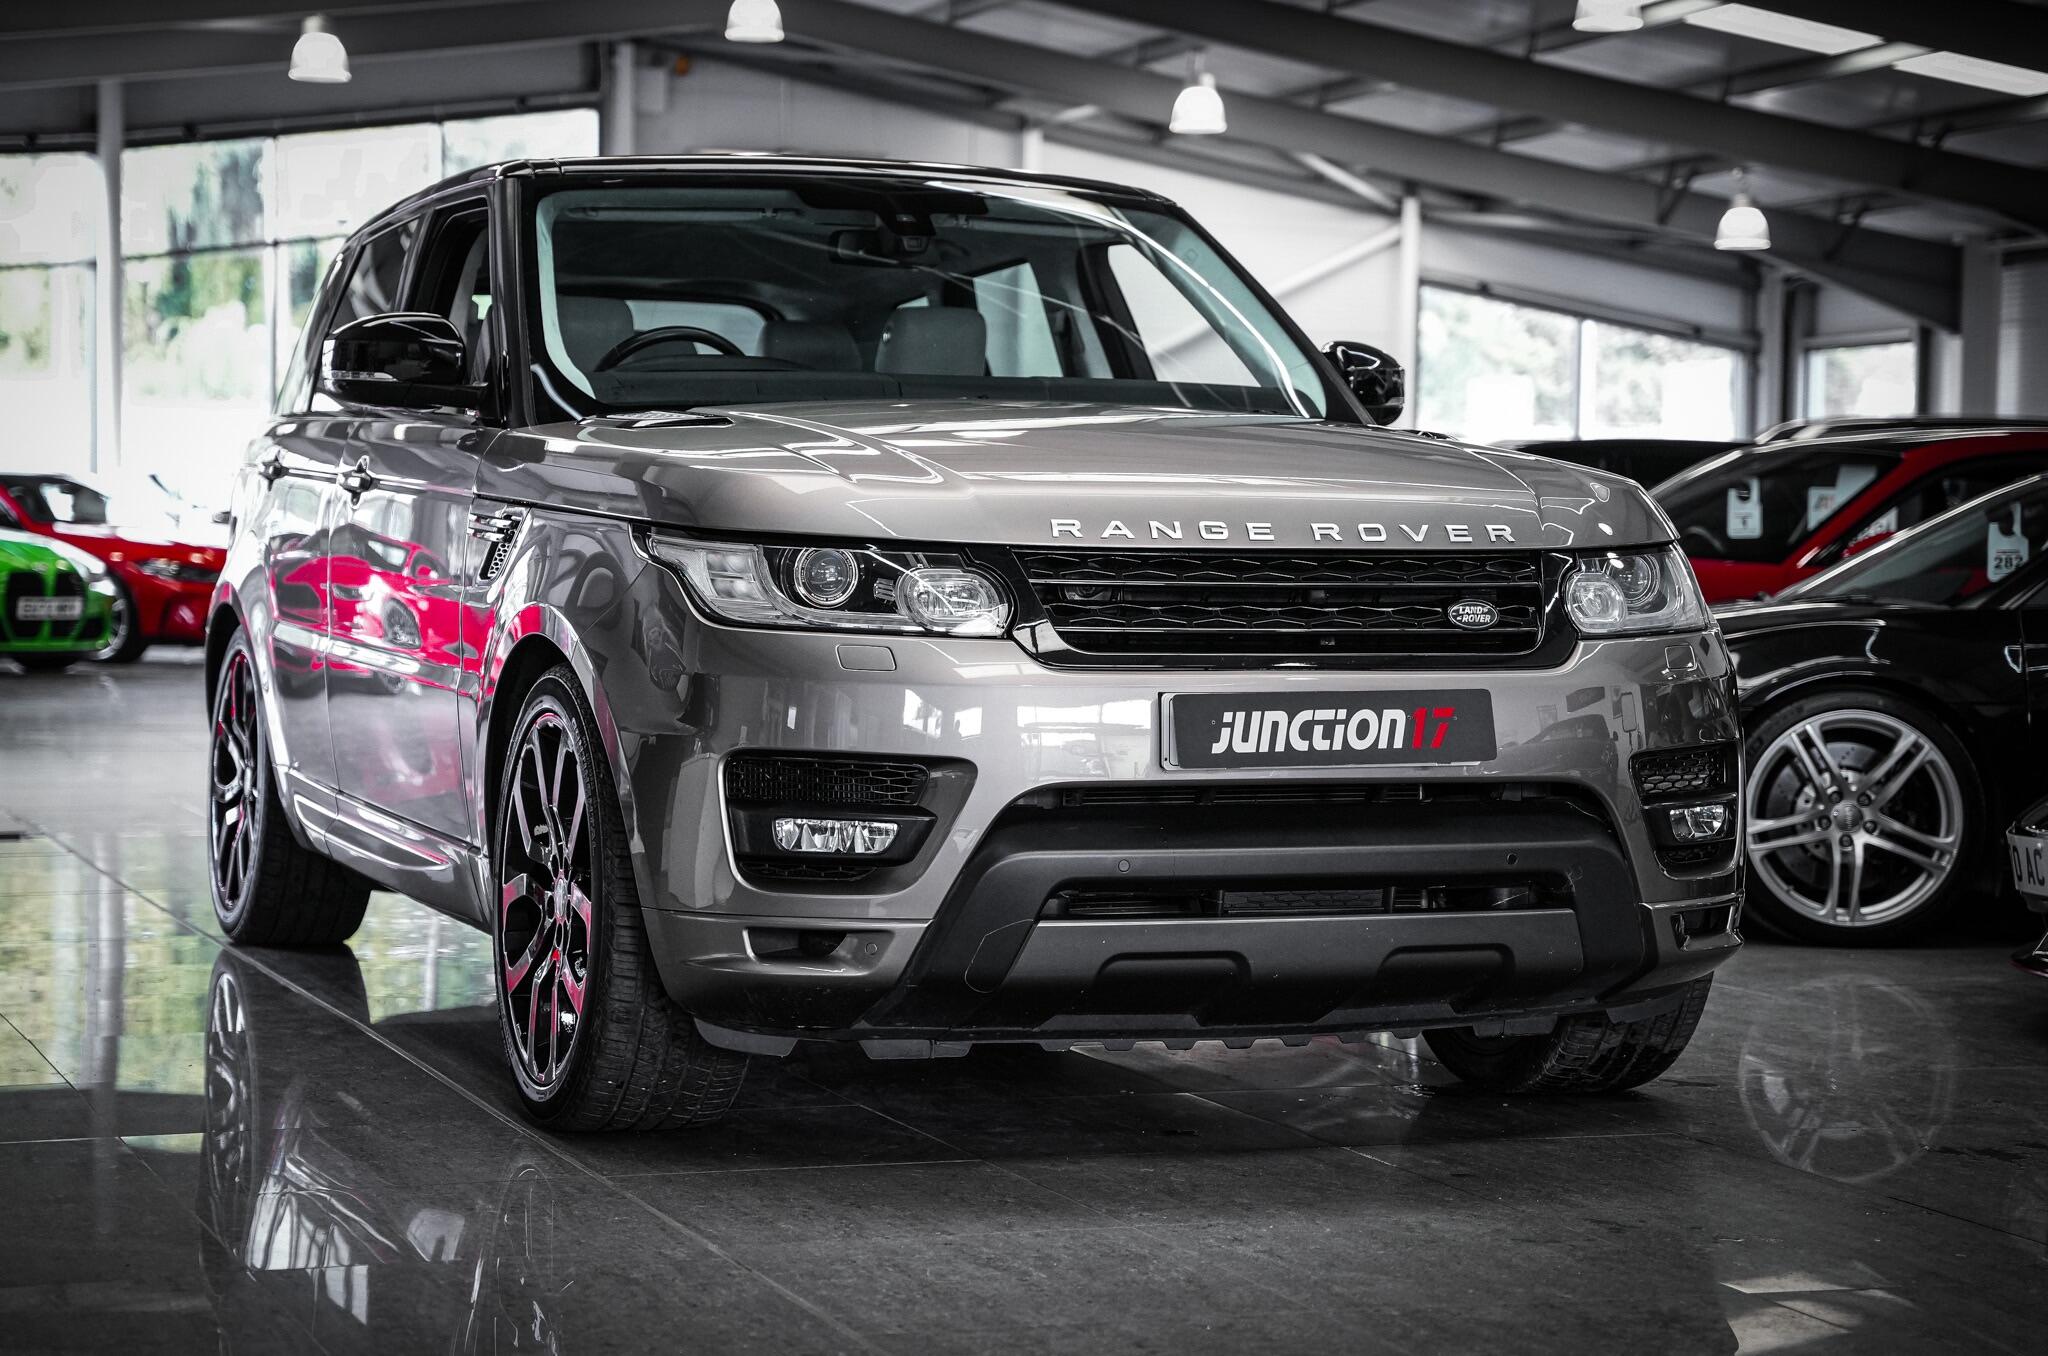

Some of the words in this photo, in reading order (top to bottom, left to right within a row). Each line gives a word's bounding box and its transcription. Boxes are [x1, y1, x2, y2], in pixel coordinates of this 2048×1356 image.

[1050, 518, 1275, 541] RANGE
[1310, 523, 1516, 543] ROVER
[1459, 606, 1482, 614] LAND
